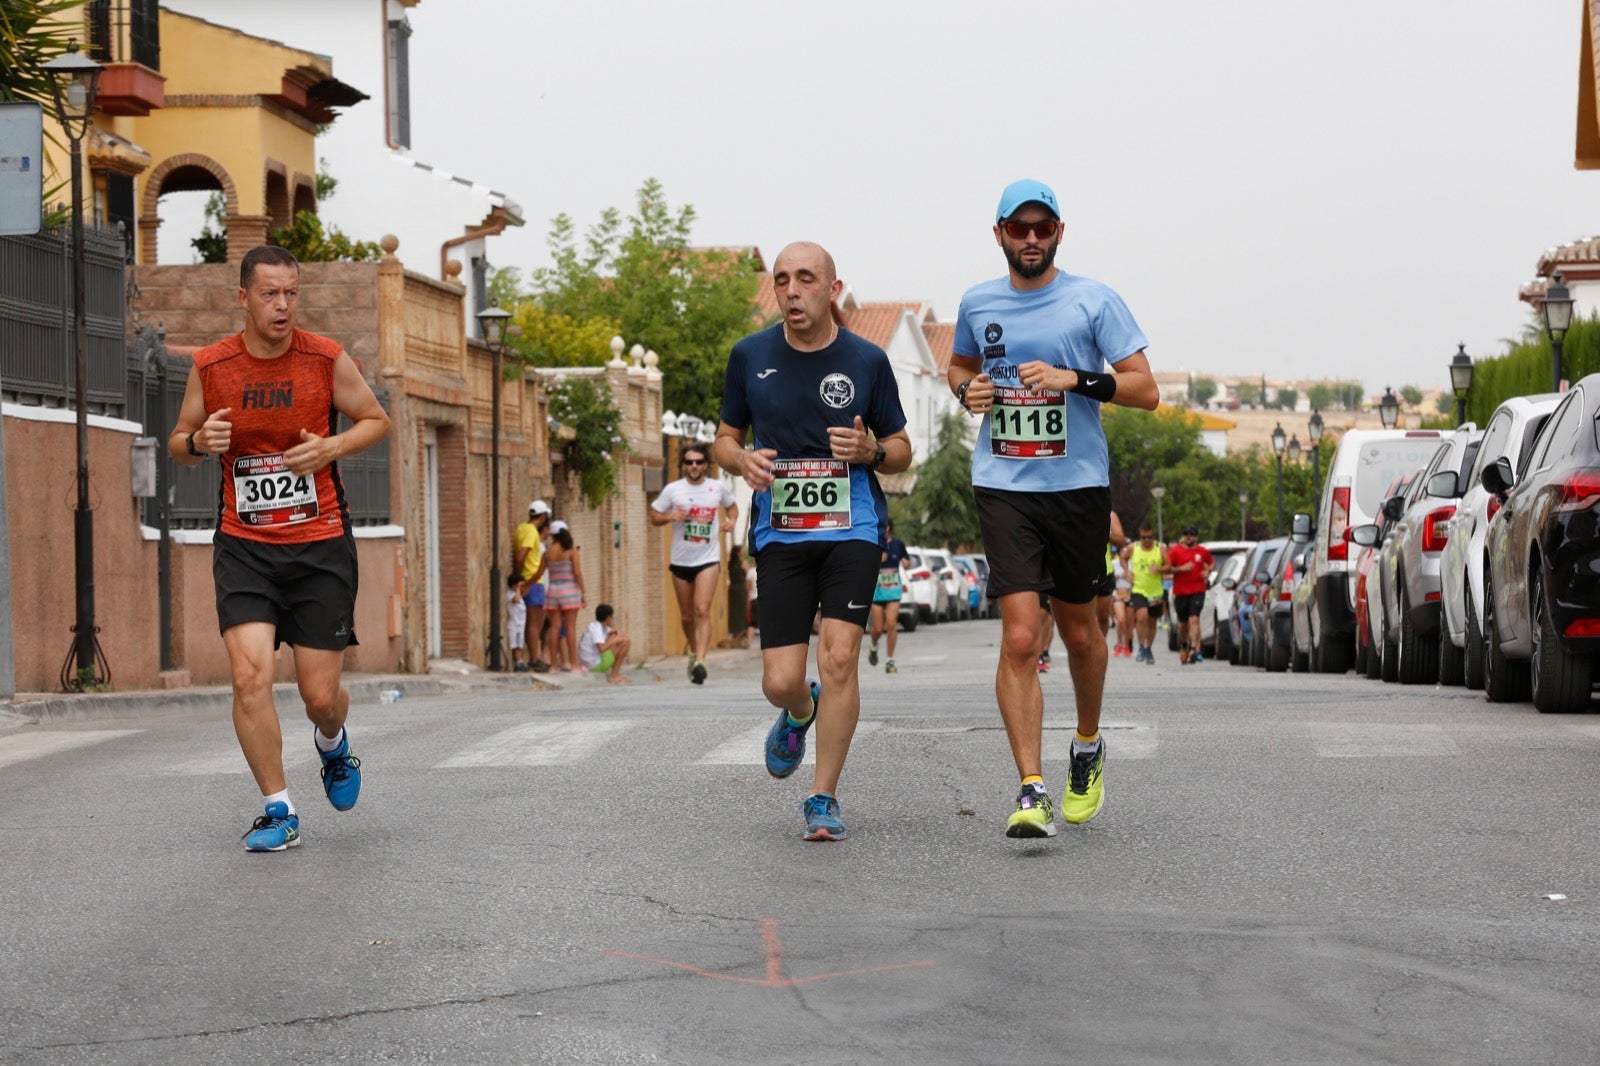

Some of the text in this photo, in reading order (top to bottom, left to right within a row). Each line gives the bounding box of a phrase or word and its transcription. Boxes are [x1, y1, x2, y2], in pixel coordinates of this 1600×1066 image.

[242, 388, 293, 410] RUN
[1003, 388, 1016, 398] GRAN
[995, 408, 1064, 436] 1118
[250, 458, 263, 467] GRAN
[263, 456, 282, 466] PREMIO
[788, 461, 801, 470] GRAN
[801, 461, 820, 470] PREMIO
[820, 461, 828, 470] DE
[828, 461, 844, 470] FONDO
[244, 475, 310, 503] 3024
[783, 481, 838, 508] 266
